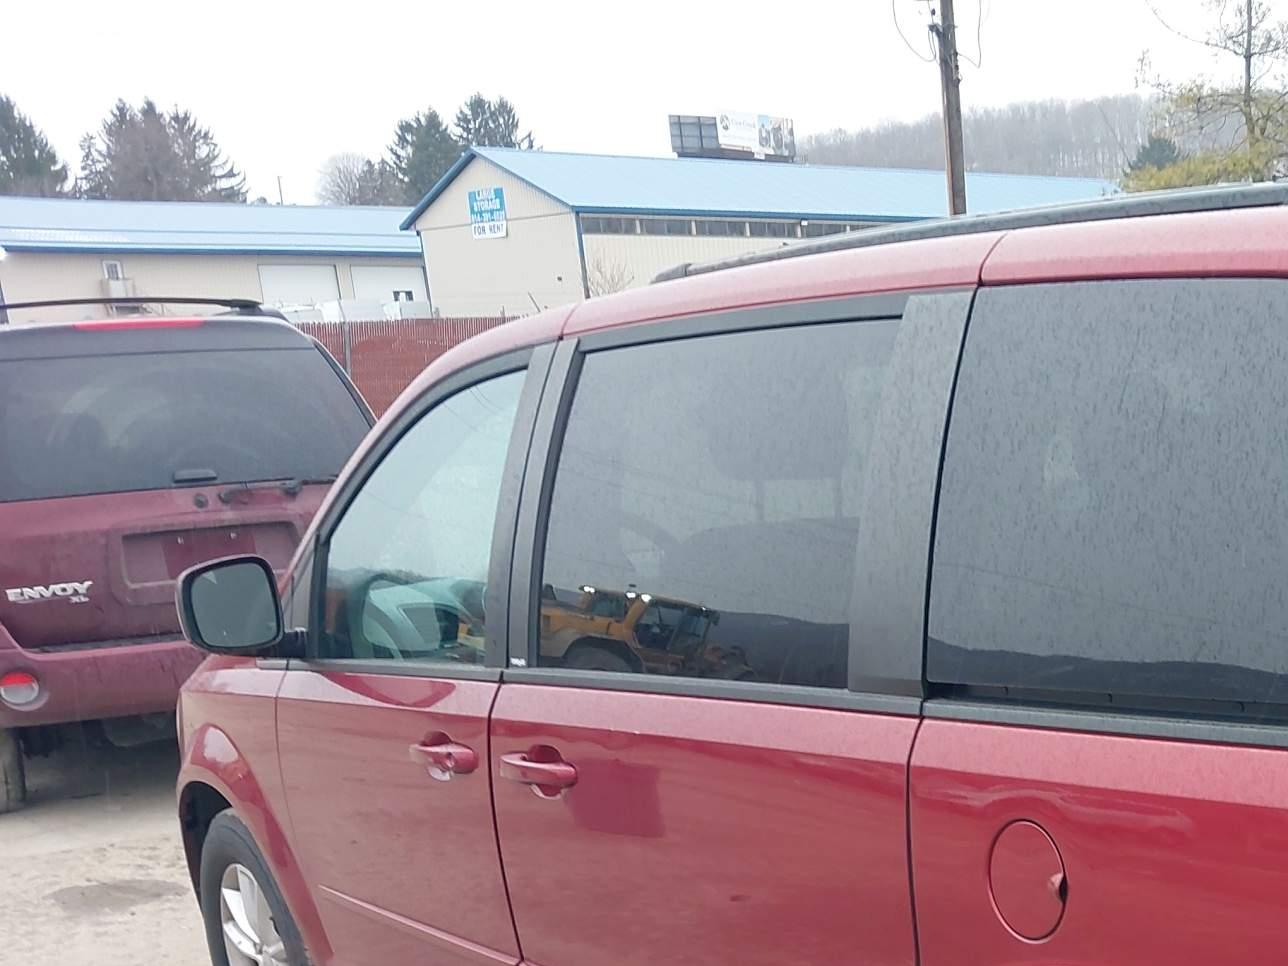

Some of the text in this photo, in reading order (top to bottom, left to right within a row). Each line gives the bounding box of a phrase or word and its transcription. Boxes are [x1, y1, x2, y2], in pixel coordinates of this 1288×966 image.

[473, 223, 505, 237] FOR RENT
[5, 580, 94, 602] ENVOY
[69, 595, 90, 604] XL
